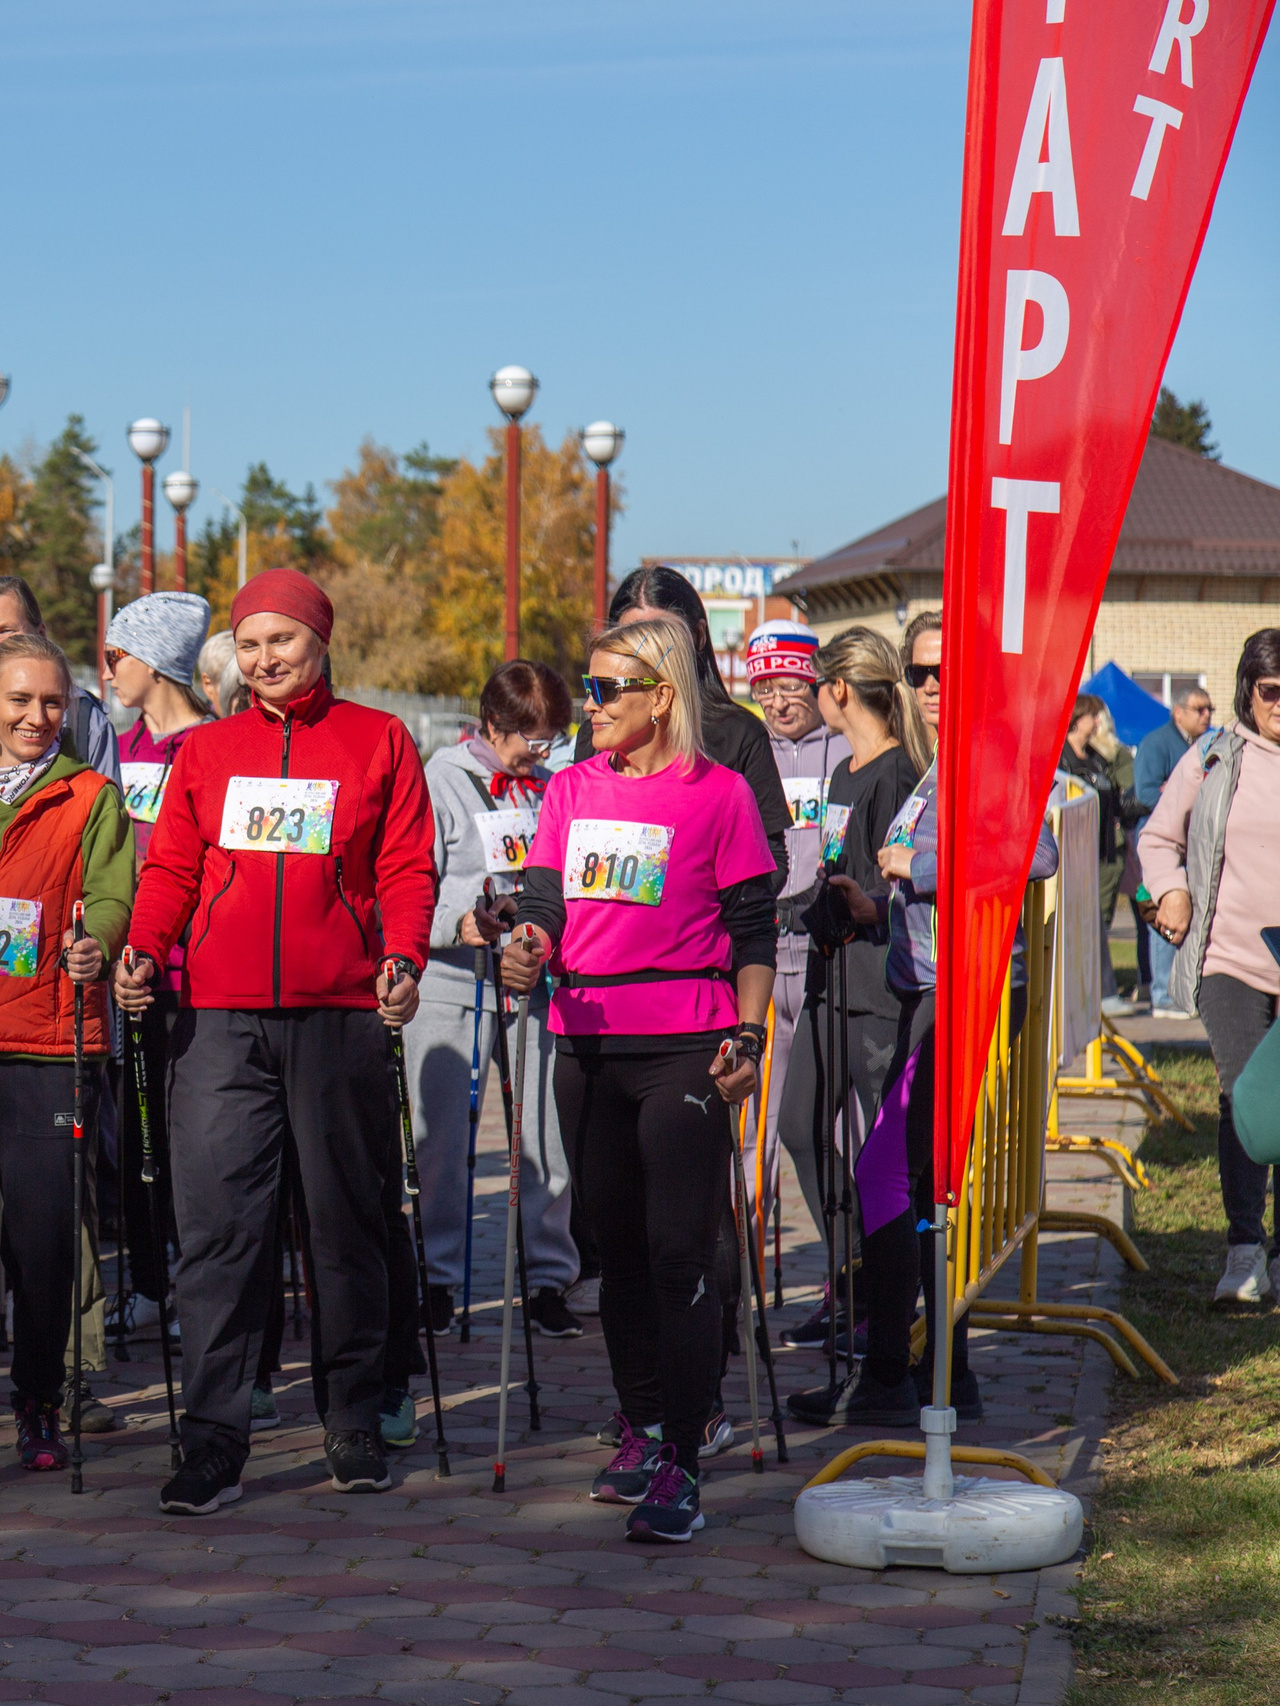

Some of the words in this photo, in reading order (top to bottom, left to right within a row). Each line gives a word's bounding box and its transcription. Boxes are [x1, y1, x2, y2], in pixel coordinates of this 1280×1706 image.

[991, 0, 1080, 655] АРТ
[679, 565, 764, 596] ОРОД
[246, 806, 306, 842] 823
[502, 834, 536, 862] 81
[581, 852, 639, 891] 810
[509, 1102, 523, 1207] PASSION
